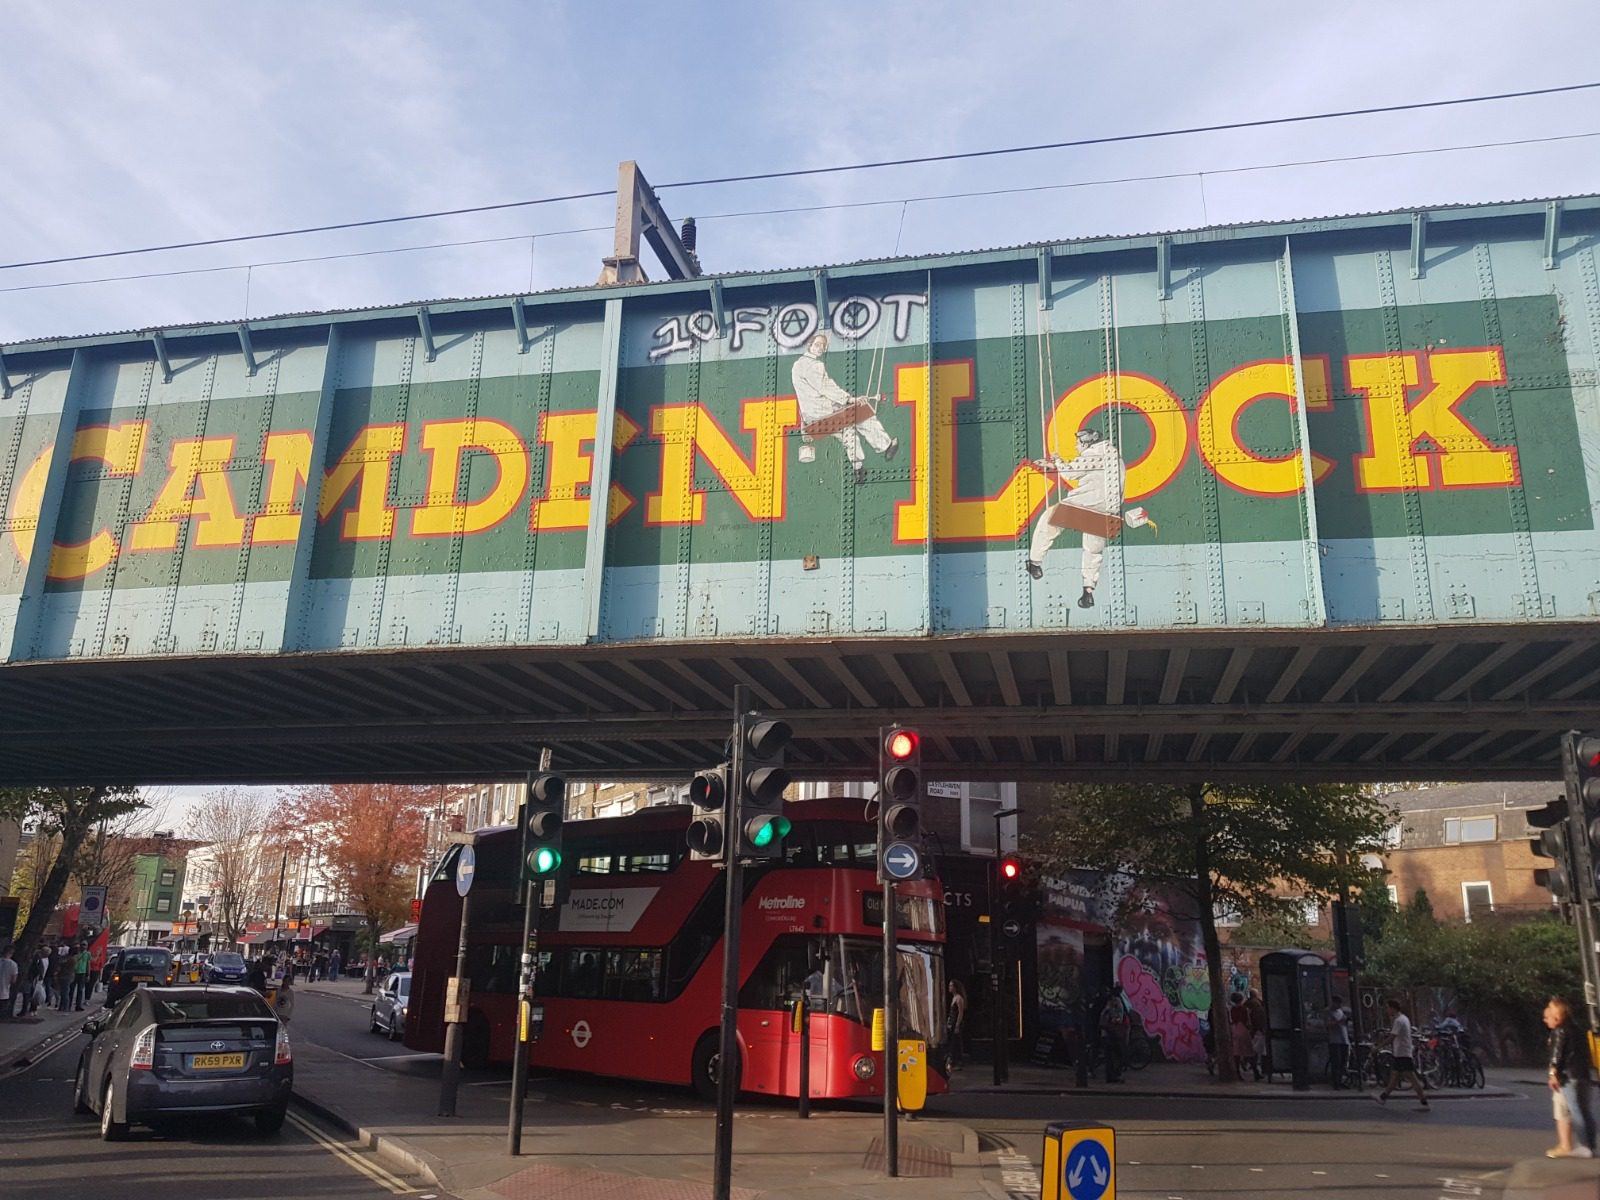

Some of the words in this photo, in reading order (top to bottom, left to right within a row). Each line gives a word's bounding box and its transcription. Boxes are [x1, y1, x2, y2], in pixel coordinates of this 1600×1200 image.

[7, 394, 801, 582] CAMDEN
[892, 346, 1521, 545] LOCK
[571, 897, 624, 910] MADE.COM
[758, 895, 806, 910] Metroline
[1048, 893, 1086, 913] PAPUA
[194, 1055, 220, 1067] RK59
[222, 1054, 241, 1066] PXR
